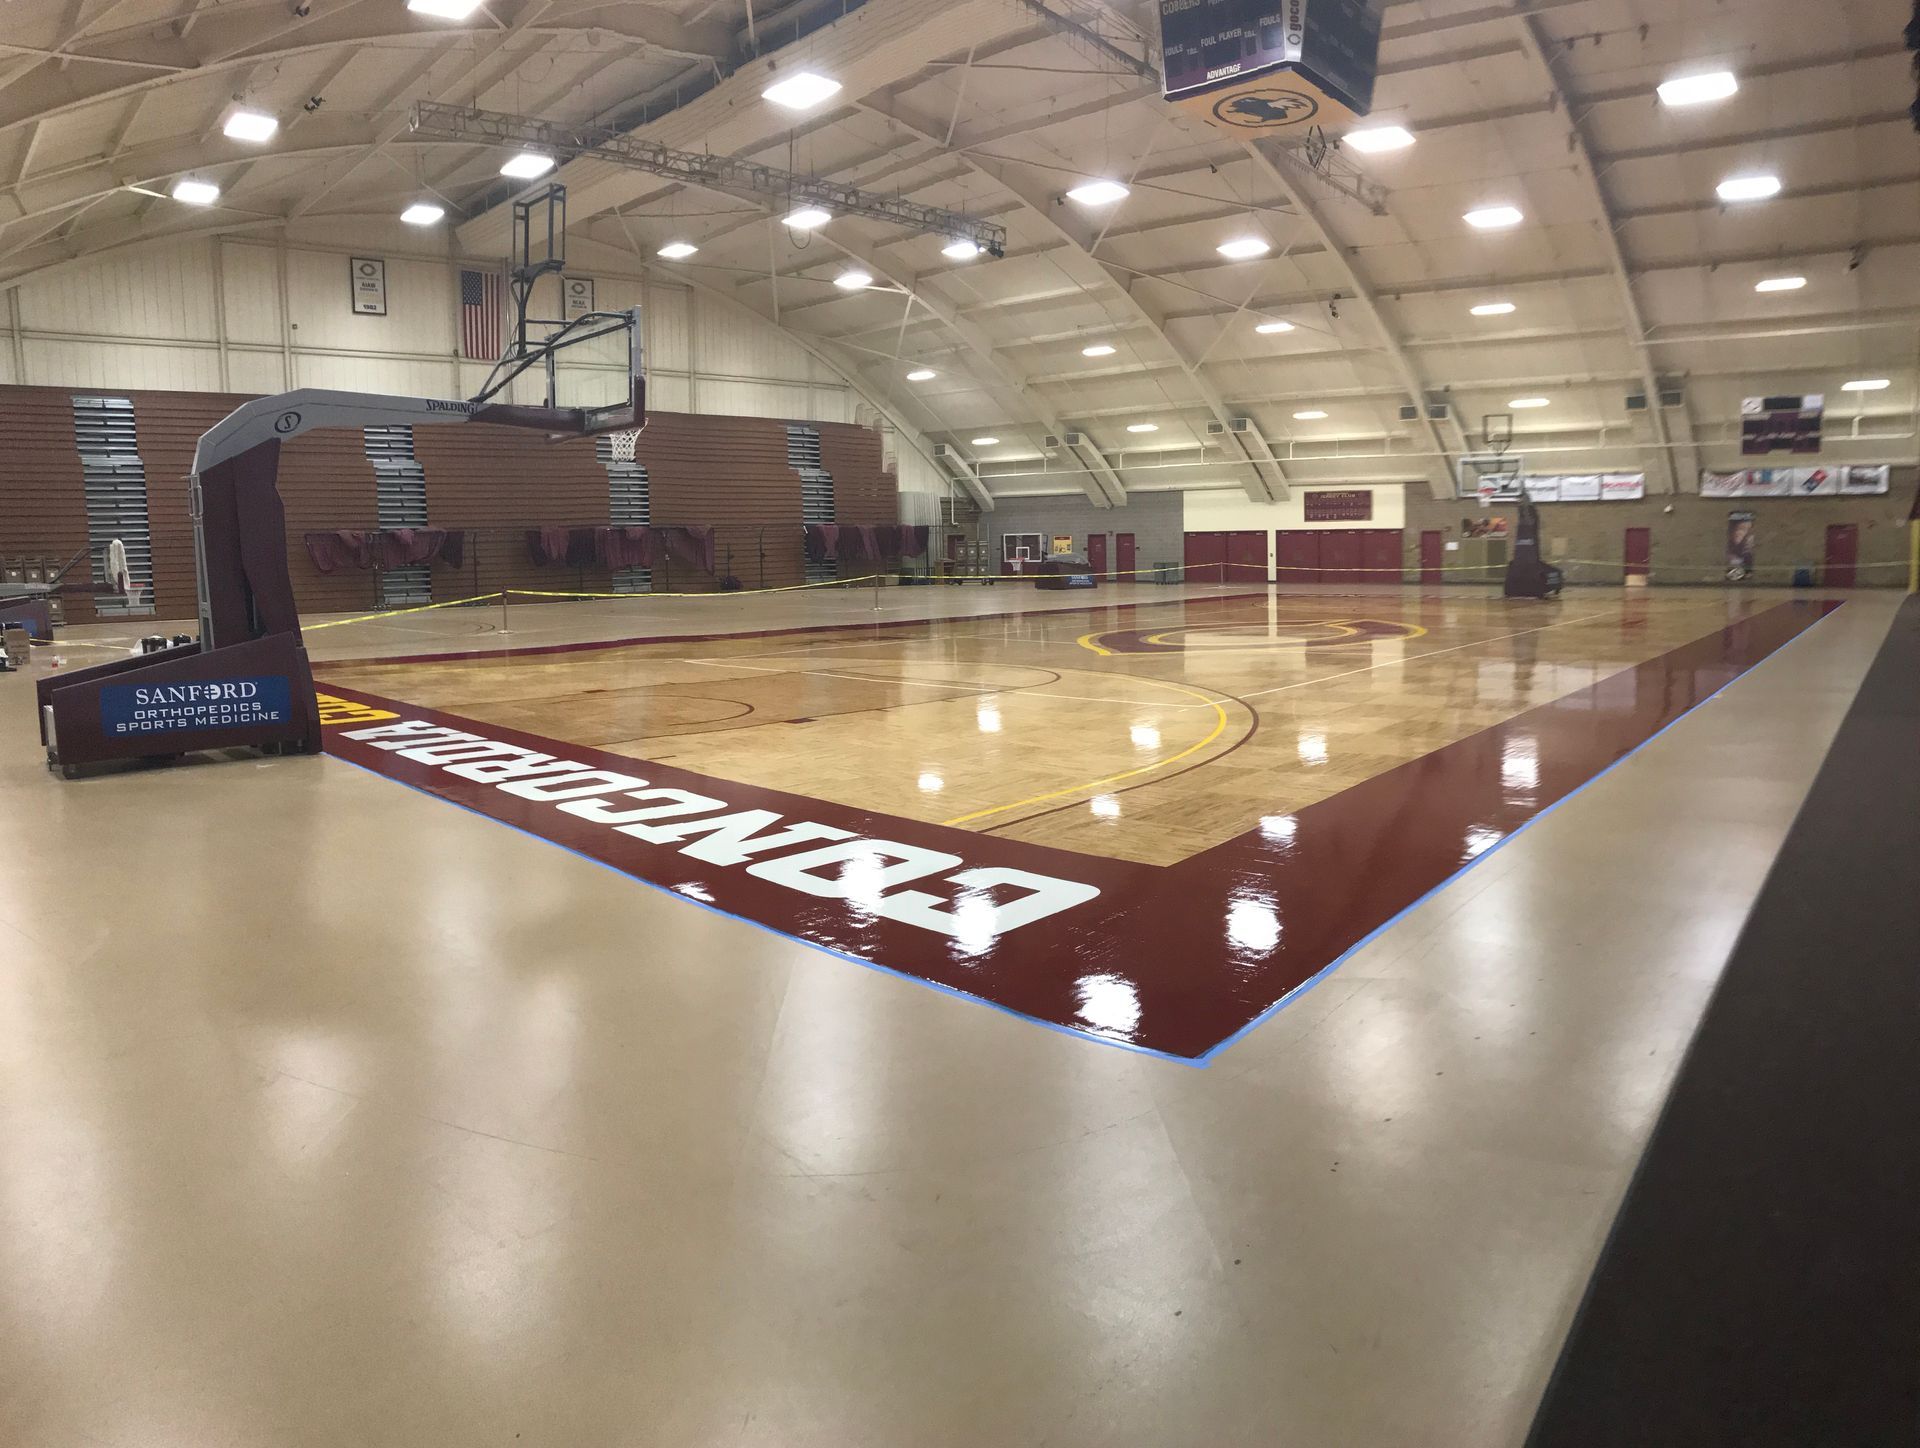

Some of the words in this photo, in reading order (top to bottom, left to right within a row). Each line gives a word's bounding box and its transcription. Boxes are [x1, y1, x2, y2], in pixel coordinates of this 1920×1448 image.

[1260, 14, 1281, 27] FOULS
[1201, 36, 1217, 48] FOUL
[1219, 28, 1242, 42] PLAYER
[1206, 63, 1241, 80] ADVANTAGE
[425, 399, 475, 415] SPALDING
[135, 681, 257, 705] SANFORD
[134, 702, 262, 720] ORTHOPEDICS
[116, 718, 187, 732] SPORTS
[195, 711, 280, 726] MEDICINE
[338, 720, 1101, 936] CONCORDIA
